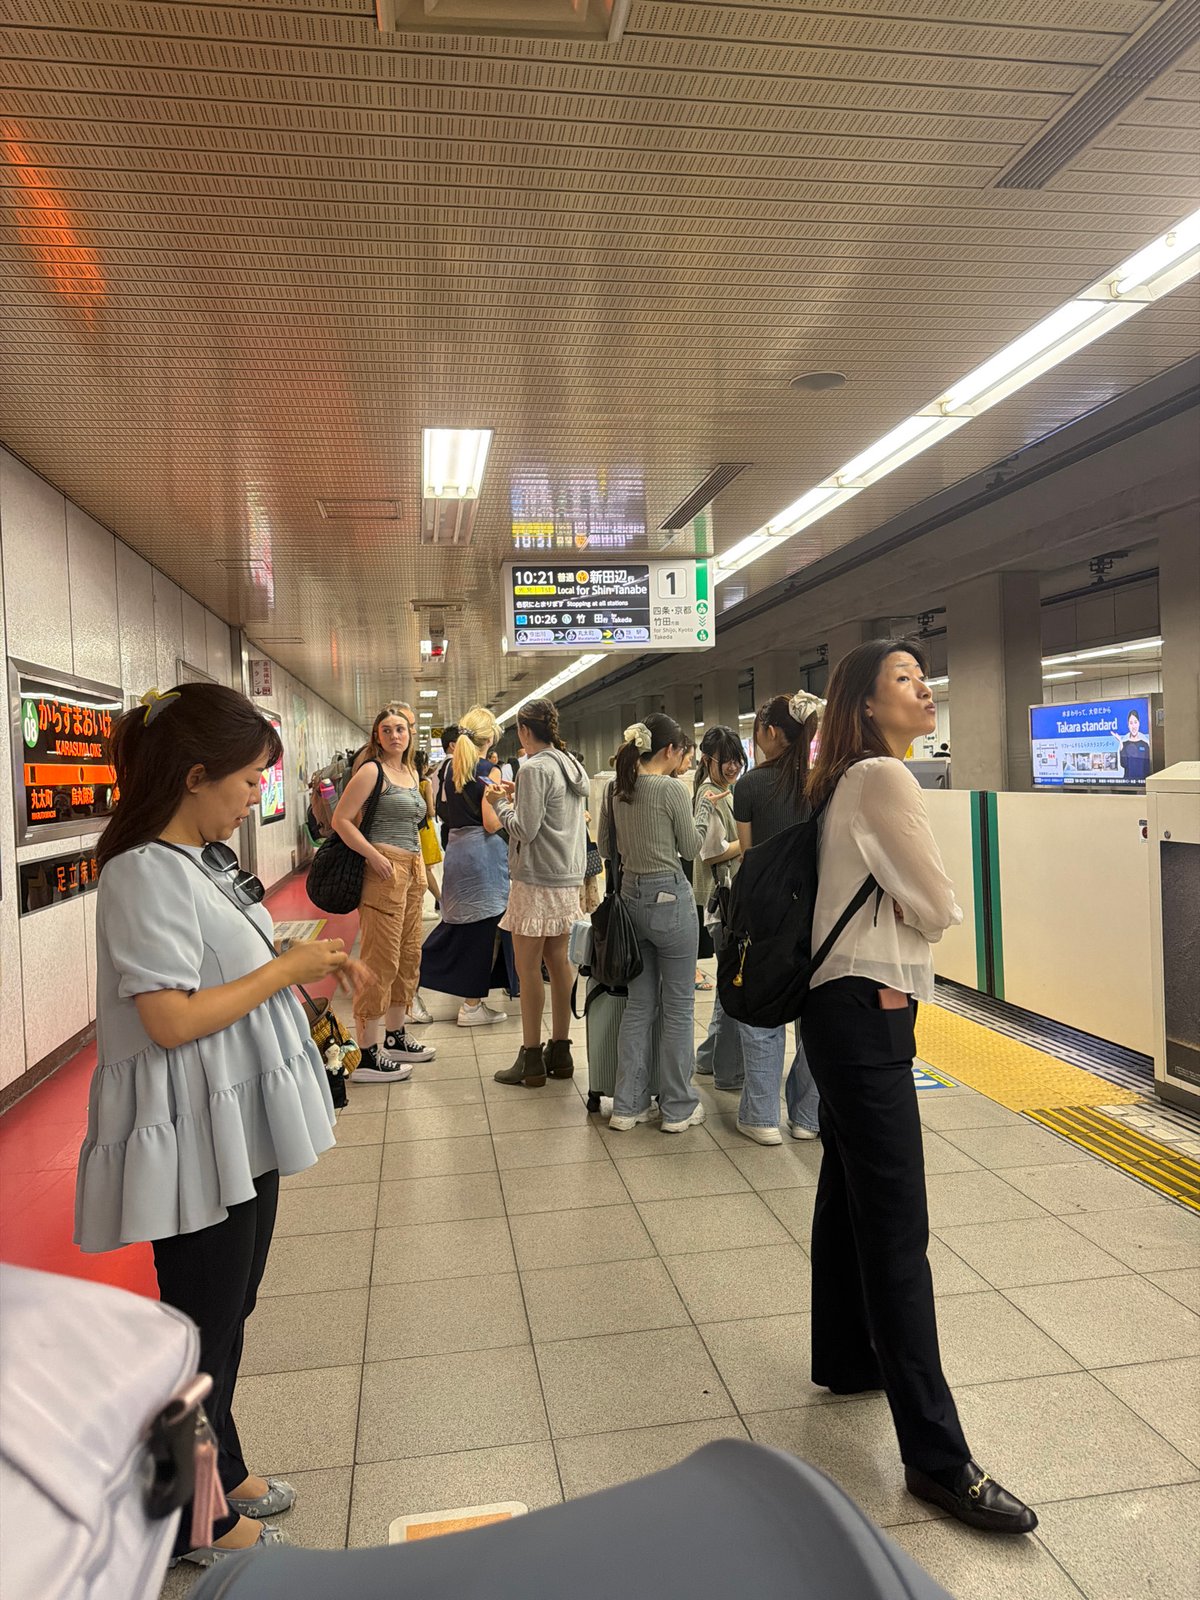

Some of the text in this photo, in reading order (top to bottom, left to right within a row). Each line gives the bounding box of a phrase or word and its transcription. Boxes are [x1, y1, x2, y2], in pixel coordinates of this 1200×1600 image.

[515, 571, 554, 585] 10:21
[666, 572, 676, 595] 1
[557, 584, 648, 596] Local for Shin-Tanabe
[566, 600, 591, 608] Stopping
[653, 606, 692, 615] 四条・京都
[528, 614, 558, 625] 10:26
[26, 701, 33, 718] K
[38, 697, 112, 739] からすまおいけ
[1056, 717, 1118, 733] Takara standard
[23, 717, 38, 742] 08
[31, 788, 53, 809] 丸太町
